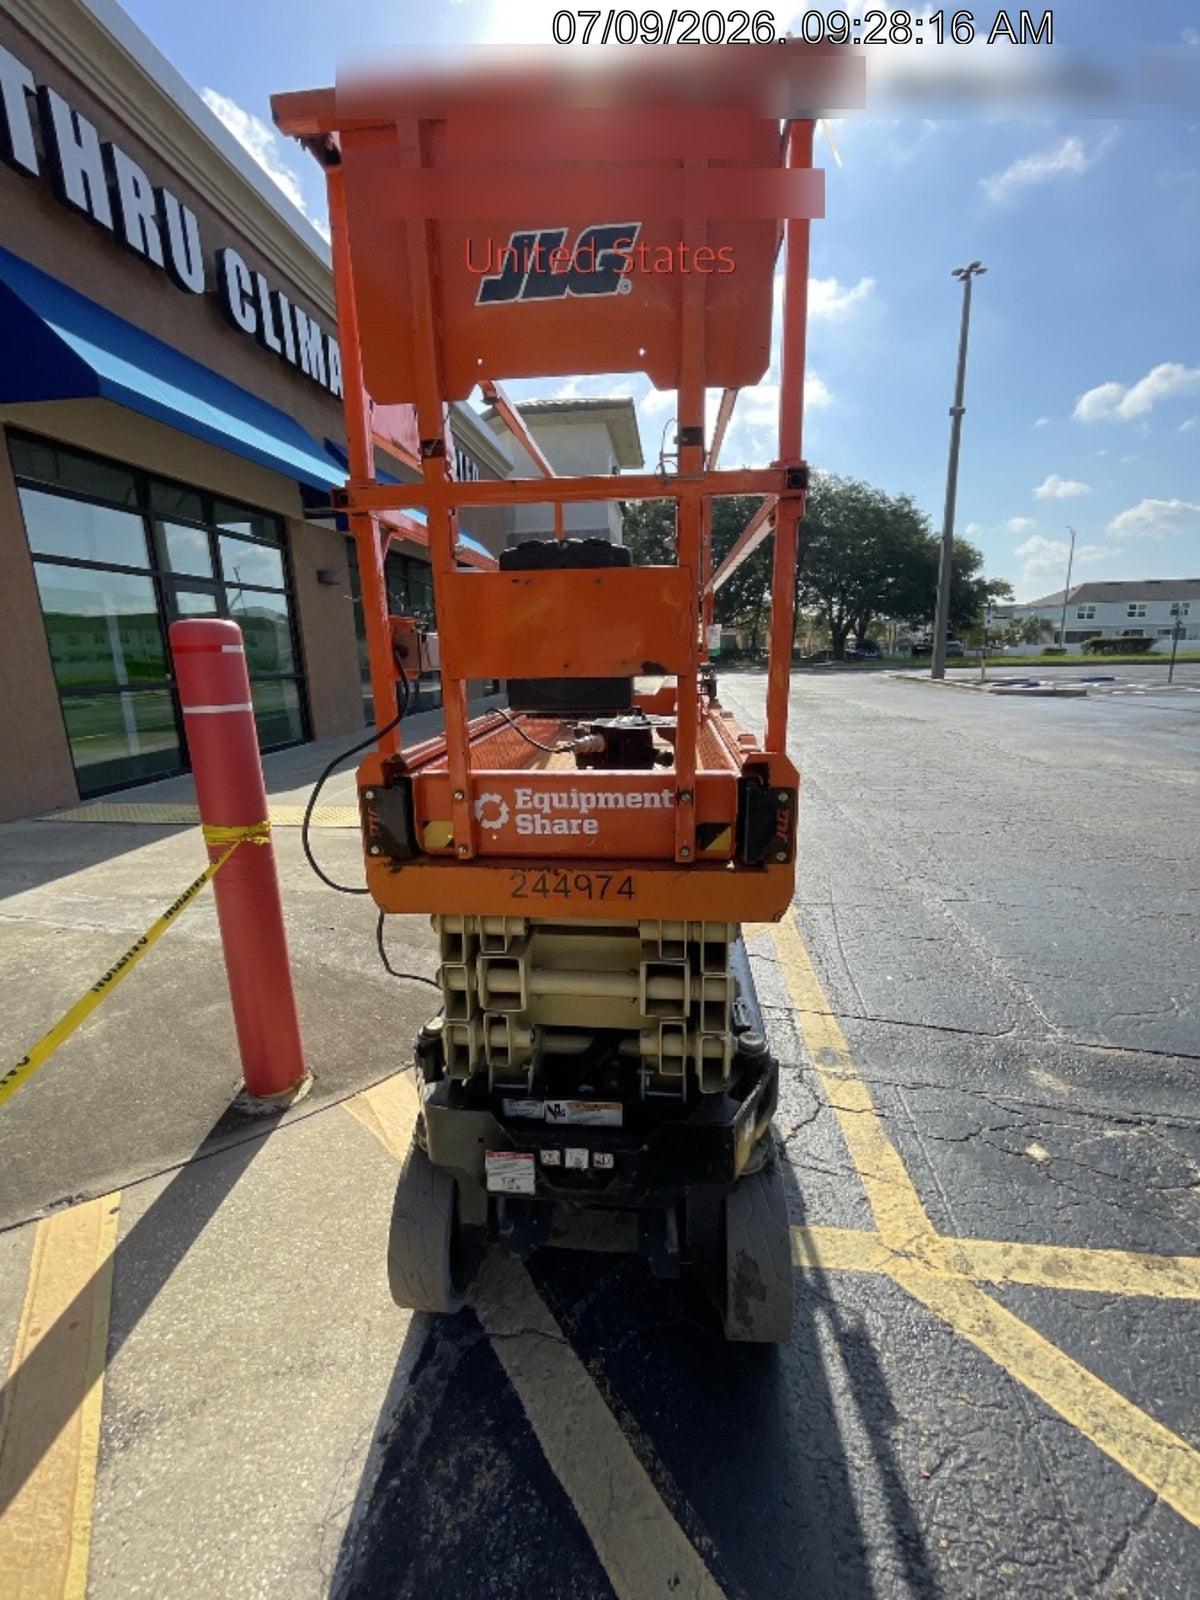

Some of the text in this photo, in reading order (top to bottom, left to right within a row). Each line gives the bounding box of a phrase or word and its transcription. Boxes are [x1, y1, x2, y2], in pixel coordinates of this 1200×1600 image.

[0, 44, 205, 294] THRU
[514, 788, 674, 812] Equipment
[516, 814, 599, 835] Share
[510, 874, 636, 900] 244974
